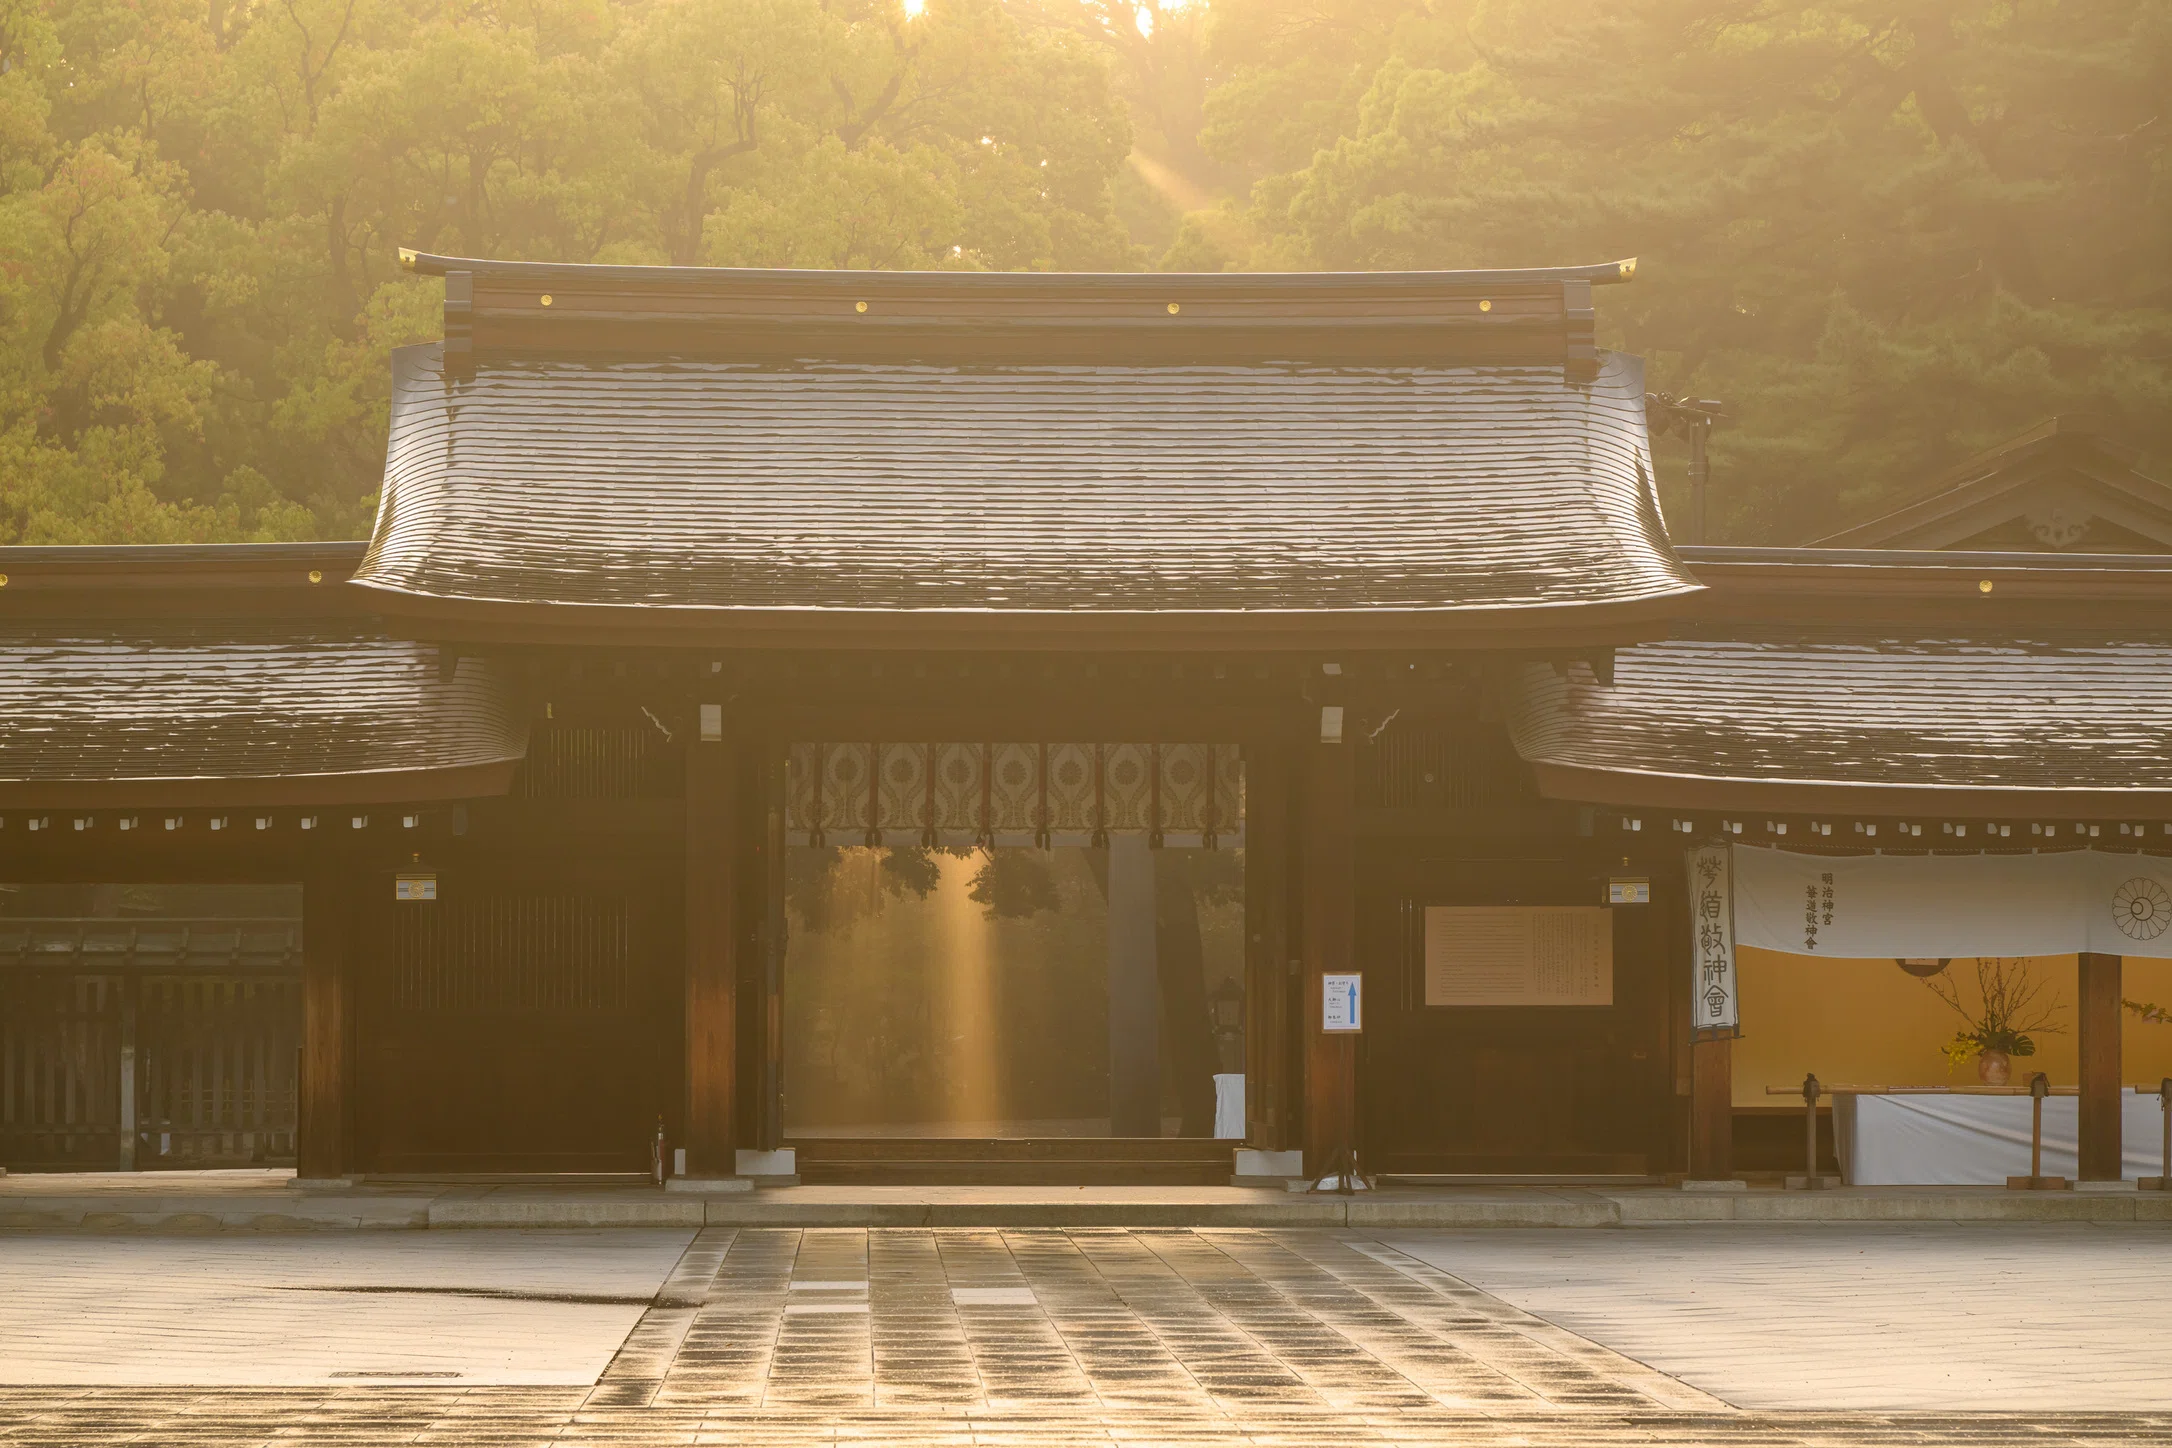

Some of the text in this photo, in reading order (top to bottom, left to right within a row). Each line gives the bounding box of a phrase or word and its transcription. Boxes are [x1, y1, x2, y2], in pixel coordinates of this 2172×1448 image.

[1804, 885, 1818, 950] 華道敬神會
[1822, 873, 1834, 925] 明治神宮
